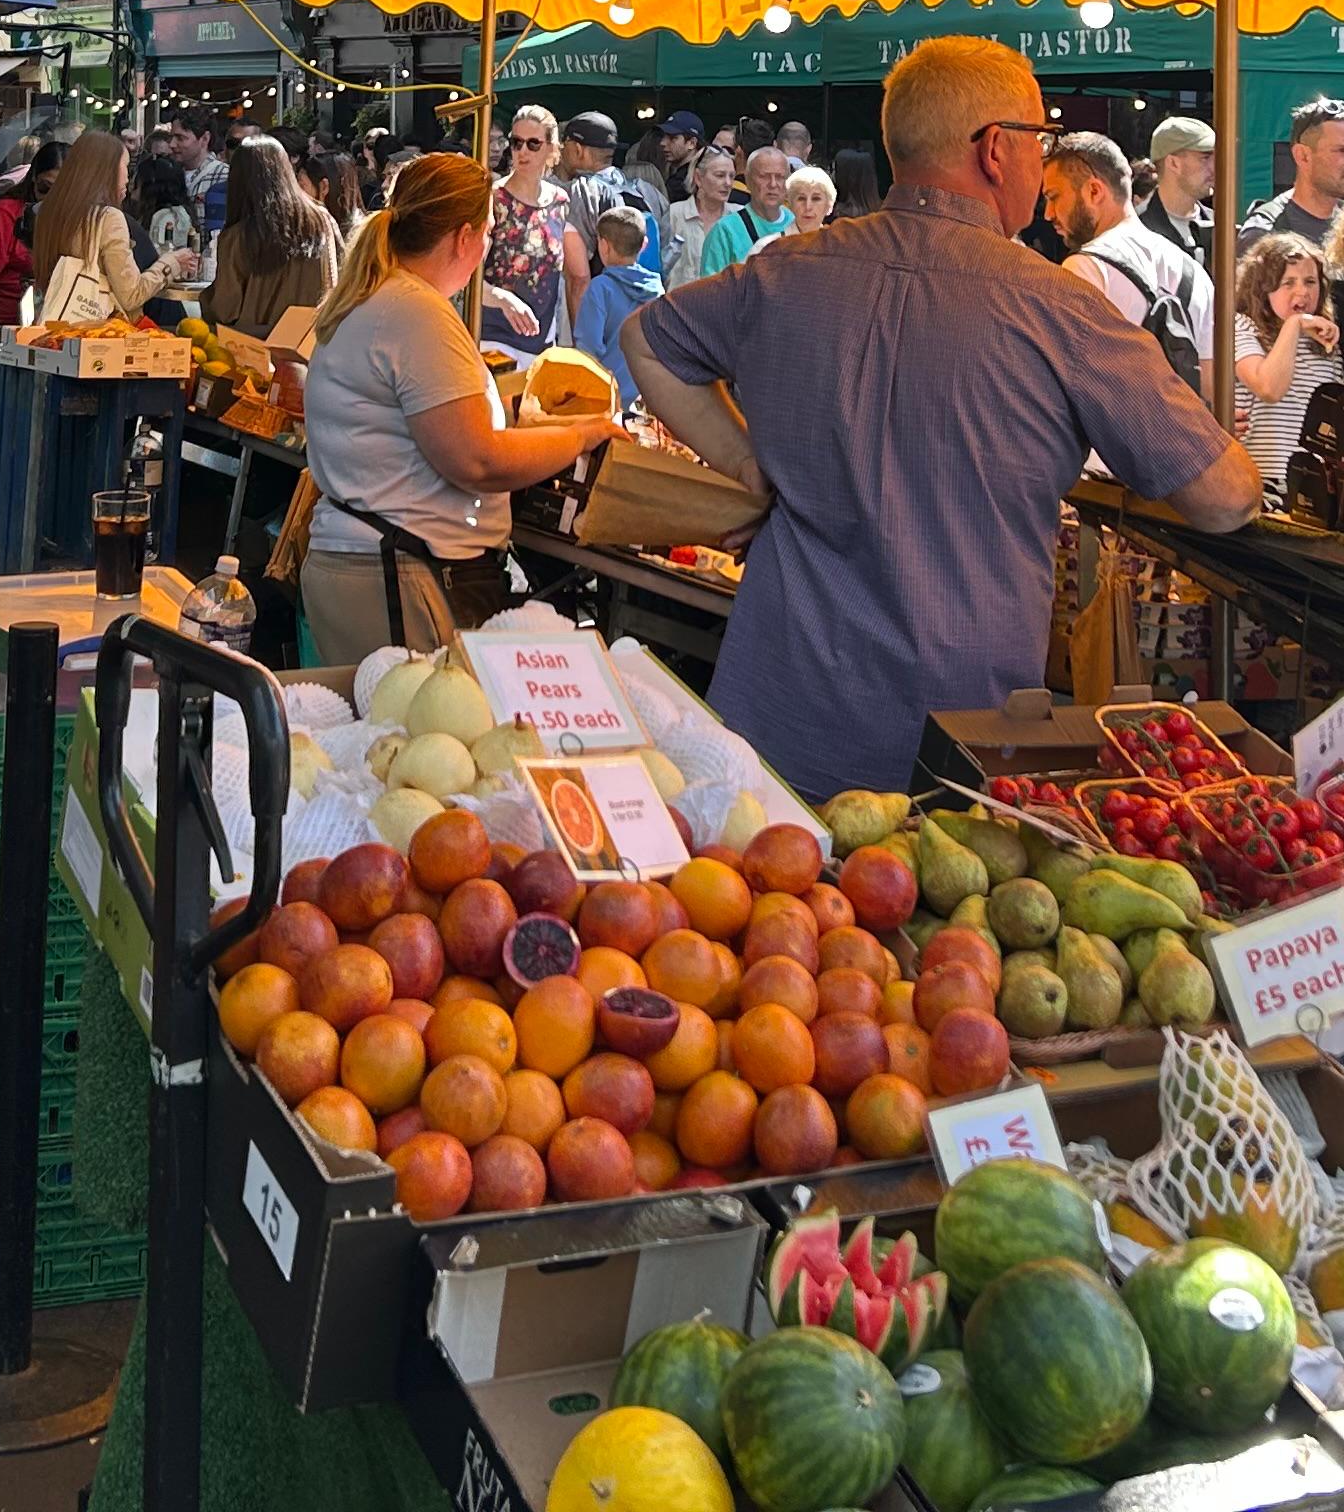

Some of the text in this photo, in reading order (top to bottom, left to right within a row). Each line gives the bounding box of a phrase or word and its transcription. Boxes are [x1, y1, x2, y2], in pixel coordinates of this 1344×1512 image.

[542, 55, 562, 75] EL
[564, 49, 619, 74] PASTÓR
[515, 650, 569, 670] Asian
[525, 680, 582, 699] Pears
[574, 710, 622, 729] each
[1245, 925, 1339, 974] Papaya
[1254, 984, 1287, 1017] £5
[261, 1182, 283, 1243] 15
